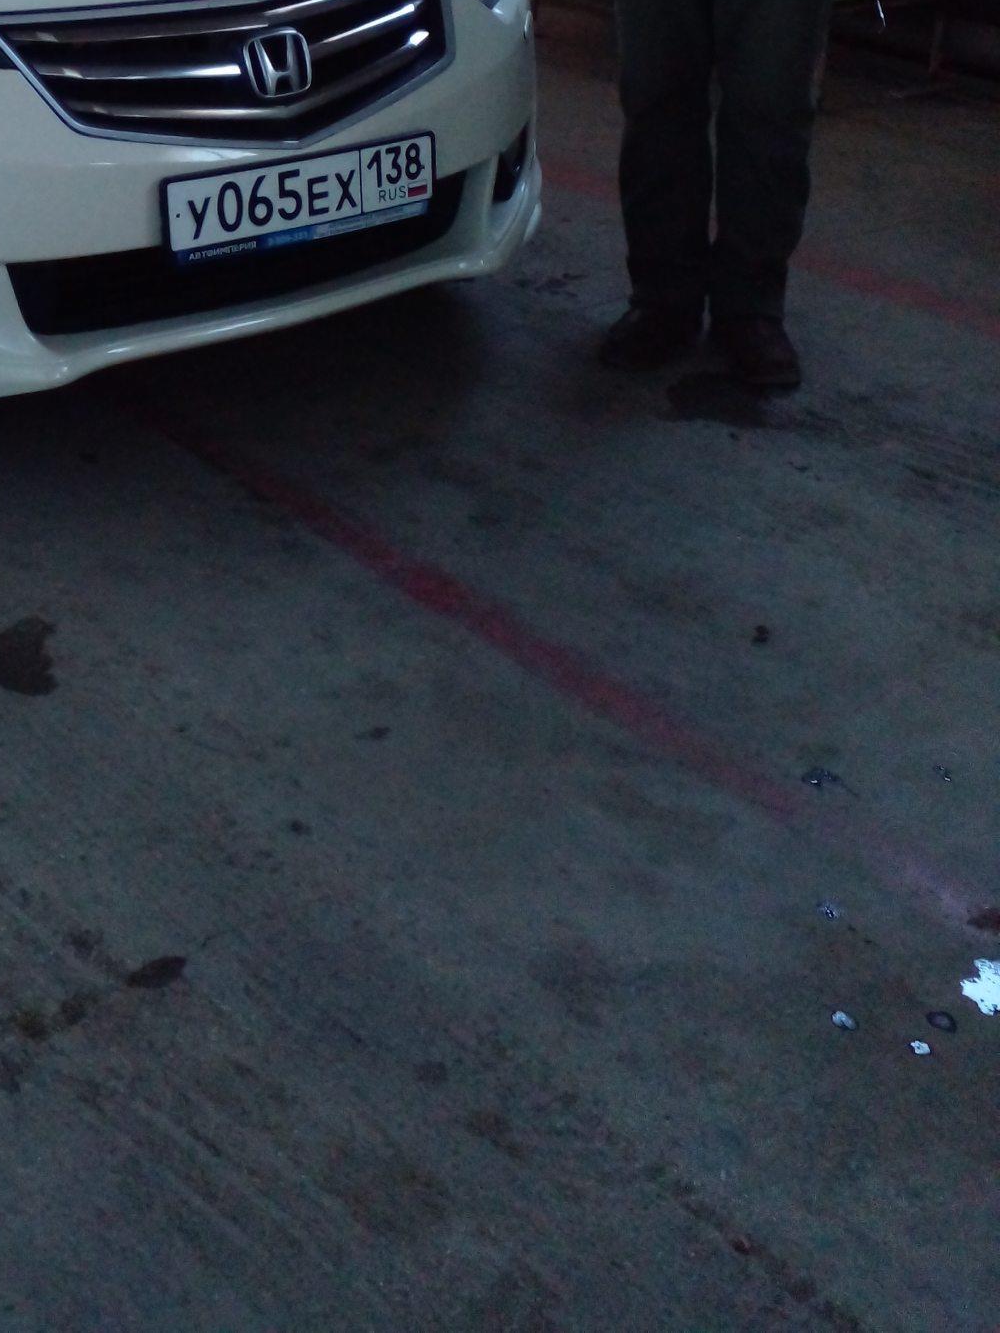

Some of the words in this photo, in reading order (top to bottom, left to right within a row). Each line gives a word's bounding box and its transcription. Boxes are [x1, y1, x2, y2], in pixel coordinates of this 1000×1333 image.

[188, 168, 357, 240] У065ЕХ
[366, 142, 425, 188] 138
[378, 185, 407, 204] RUS
